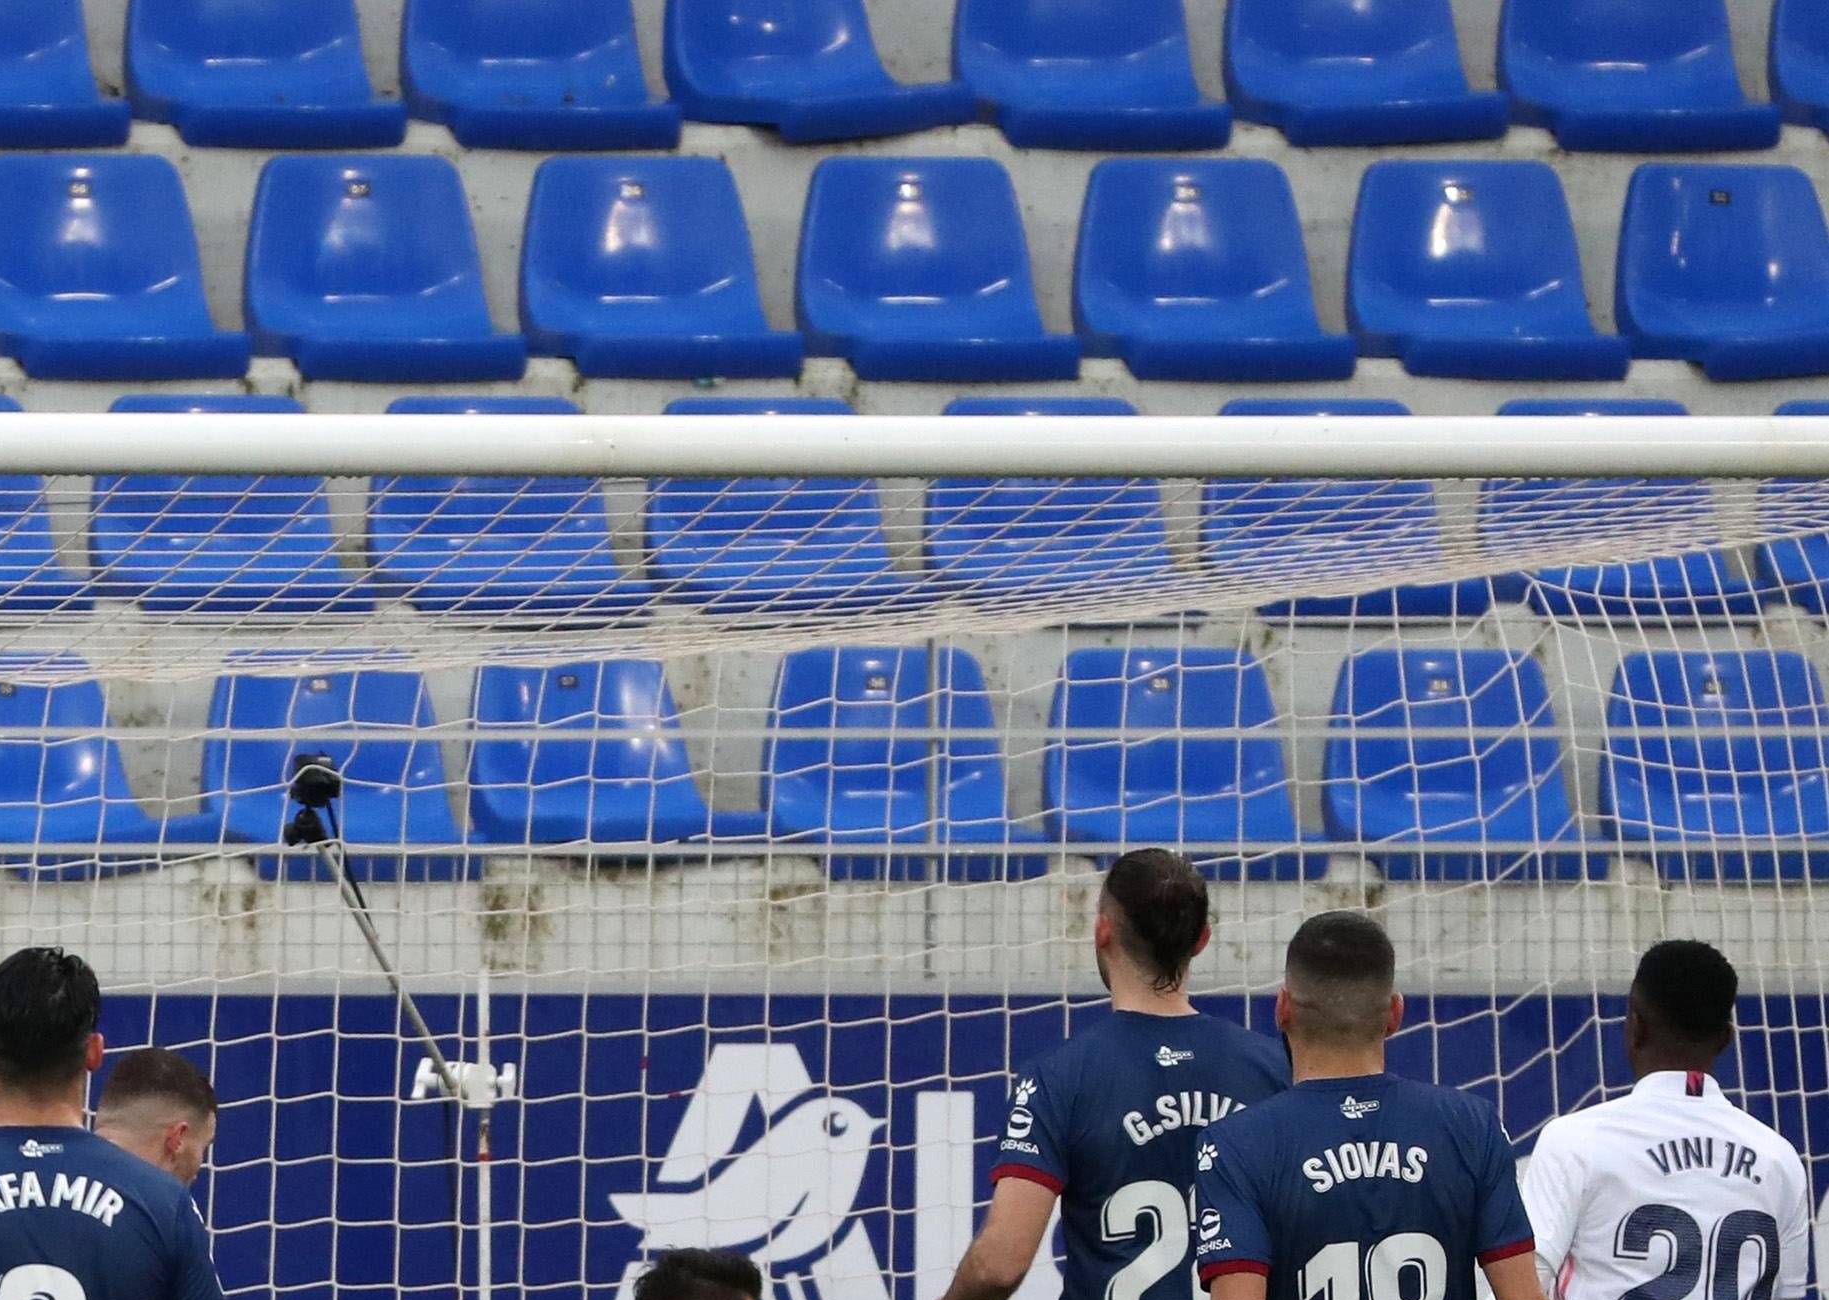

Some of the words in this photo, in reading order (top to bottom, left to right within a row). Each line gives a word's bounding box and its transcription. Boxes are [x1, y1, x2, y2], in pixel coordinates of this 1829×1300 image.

[1302, 1140, 1429, 1193] SIOVAS
[1645, 1136, 1714, 1177] VINI
[1721, 1140, 1763, 1185] JR.
[49, 1174, 125, 1228] MIR
